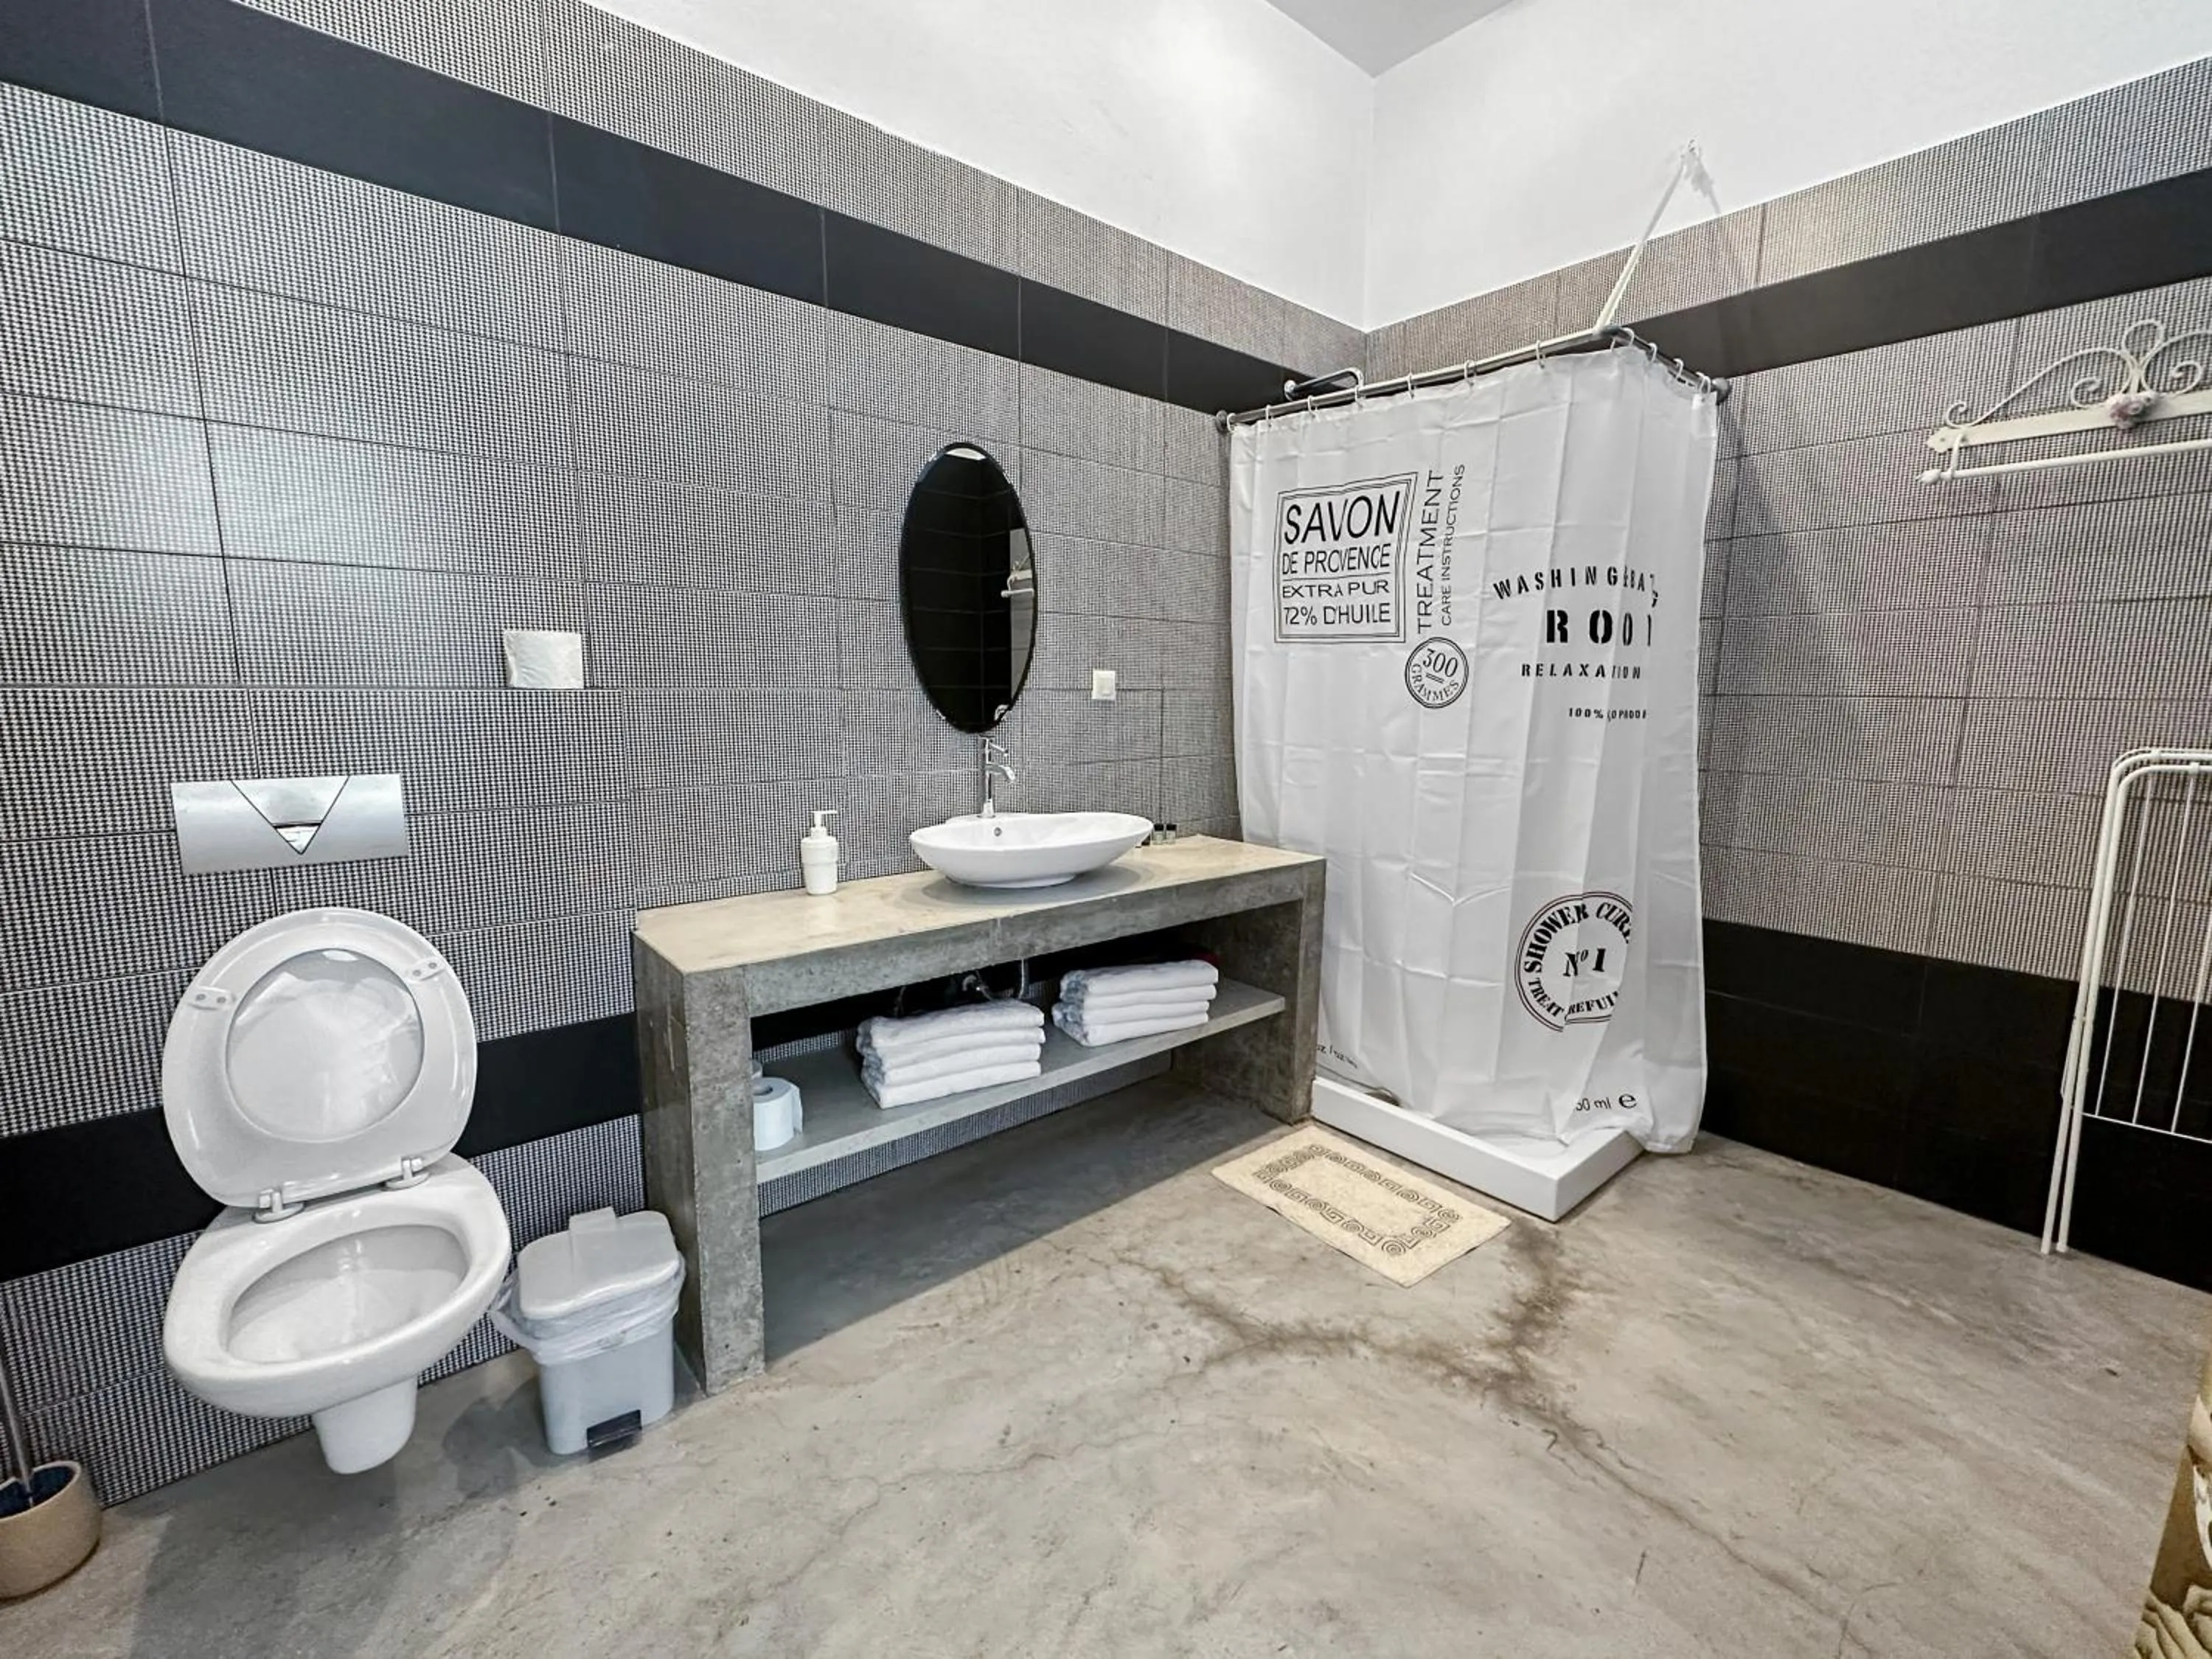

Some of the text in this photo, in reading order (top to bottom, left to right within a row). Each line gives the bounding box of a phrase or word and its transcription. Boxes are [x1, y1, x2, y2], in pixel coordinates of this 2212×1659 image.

[1284, 491, 1399, 544] SAVON
[1282, 543, 1391, 574] DE PROVENCE
[1416, 470, 1444, 633] TREATMENT
[1441, 464, 1465, 626] CARE INSTRUCTIONS
[1282, 580, 1390, 598] EXTRA PUR
[1493, 566, 1618, 599] WASHING
[1423, 648, 1458, 677] 300
[1521, 664, 1641, 679] RELAXATION
[1411, 664, 1459, 701] GRAMMES
[1569, 708, 1604, 719] 100%
[1523, 902, 1589, 973] SHOWER
[1593, 948, 1606, 973] 1
[1593, 1097, 1611, 1109] ml
